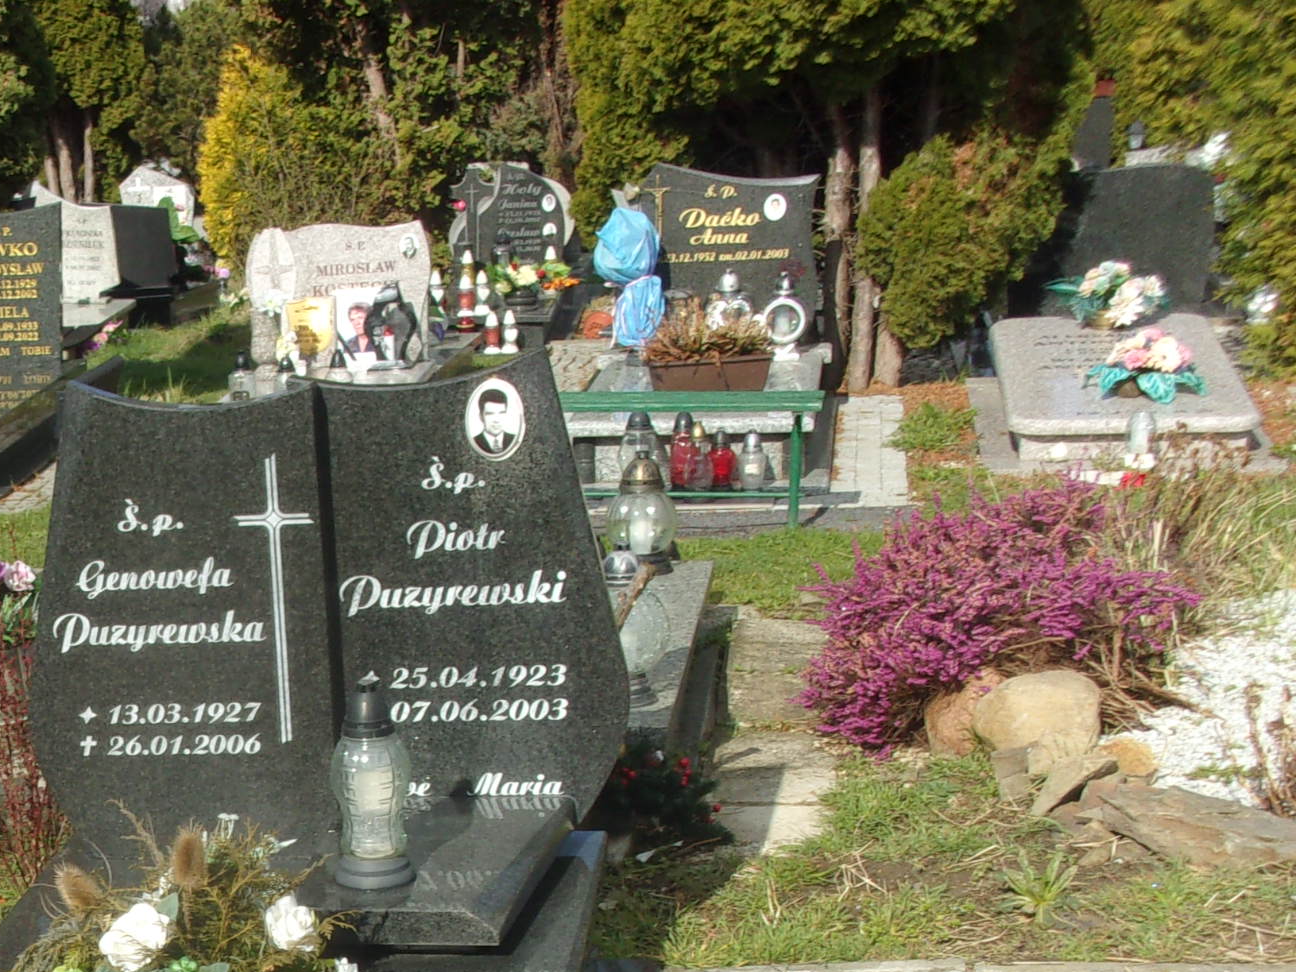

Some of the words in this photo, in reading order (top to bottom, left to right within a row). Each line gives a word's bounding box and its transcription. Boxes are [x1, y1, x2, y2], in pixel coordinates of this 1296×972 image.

[689, 228, 749, 246] Anna
[20, 345, 54, 356] TOBIE
[406, 519, 506, 560] Piotr
[75, 556, 235, 600] Genowefa
[339, 569, 568, 618] Puzyrewski
[53, 609, 267, 654] Puzyrewska
[389, 663, 568, 690] 25.04.1923
[107, 701, 262, 726] 13.03.1927
[389, 697, 569, 723] 07.06.2003
[106, 733, 262, 757] 26.01.2006
[466, 771, 566, 797] Maria
